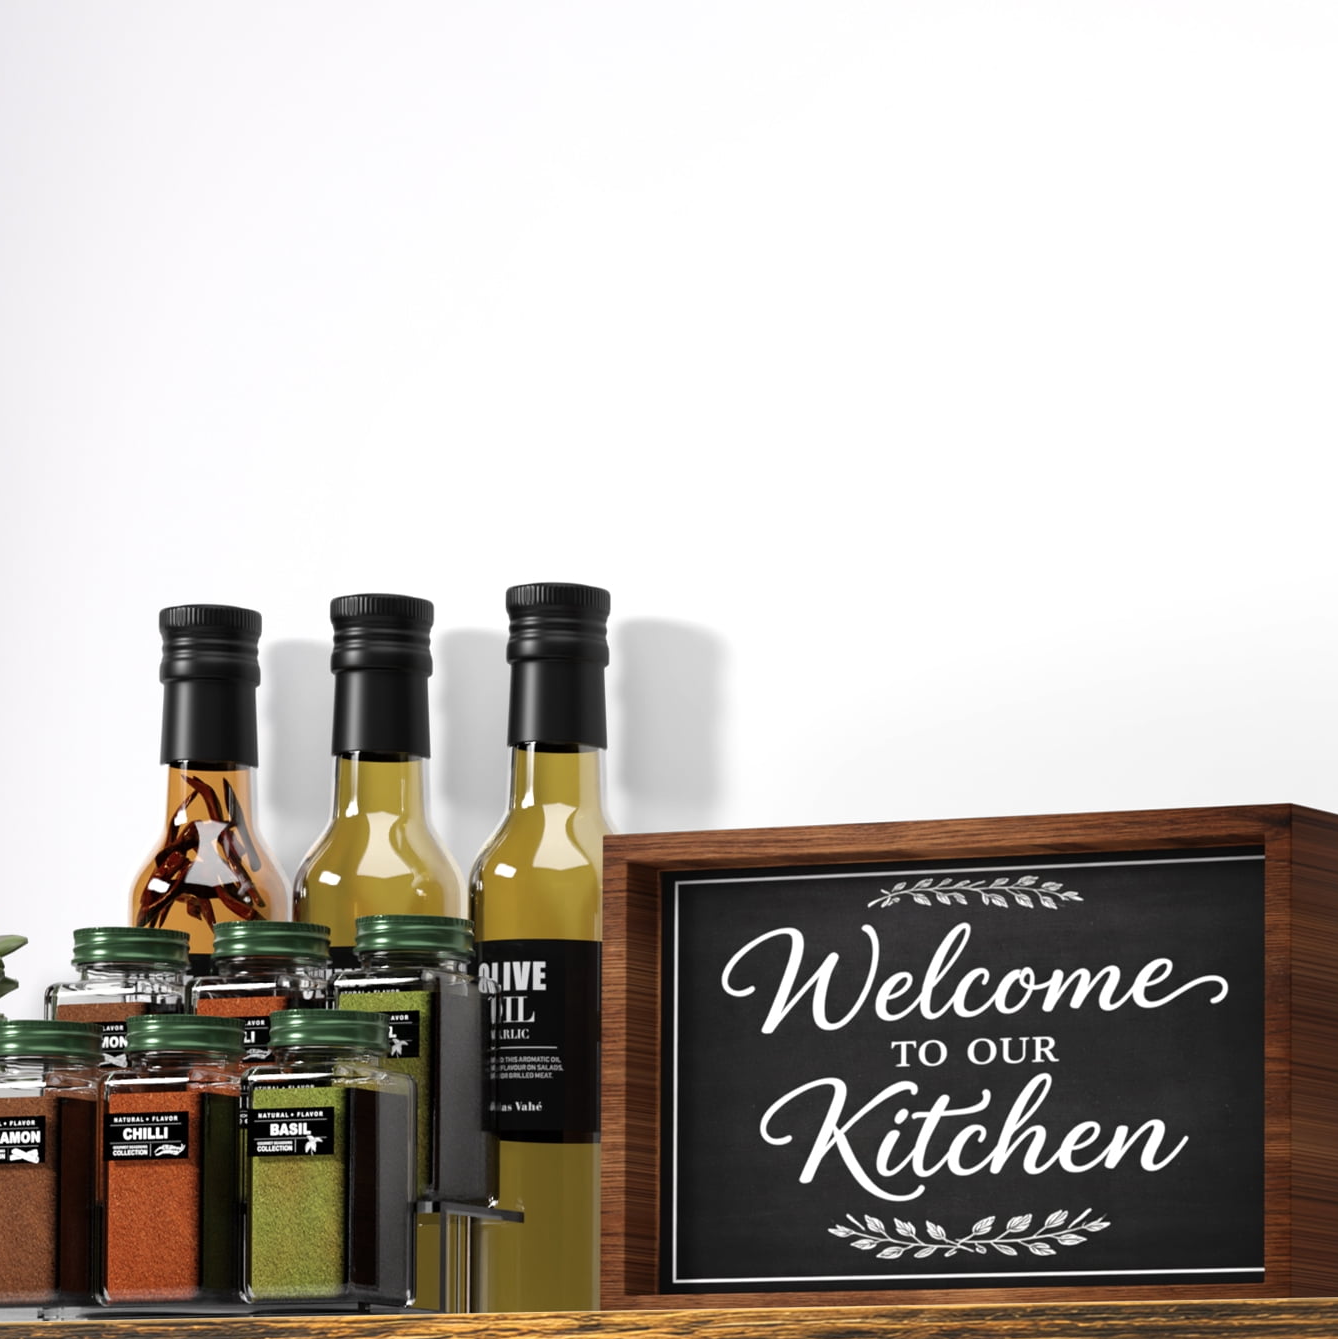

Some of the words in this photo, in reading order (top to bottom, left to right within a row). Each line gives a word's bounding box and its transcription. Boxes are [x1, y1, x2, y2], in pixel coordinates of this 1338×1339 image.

[721, 922, 1229, 1034] Welcome
[891, 1040, 949, 1068] TO
[967, 1036, 1060, 1066] OUR
[152, 1114, 179, 1122] FLAVOR
[257, 1111, 289, 1119] NATURAL
[296, 1110, 324, 1118] FLAVOR
[9, 1119, 36, 1127] FLAVOR
[269, 1122, 312, 1137] BASIL
[122, 1126, 169, 1141] CHILLI
[760, 1072, 1189, 1202] Kitchen
